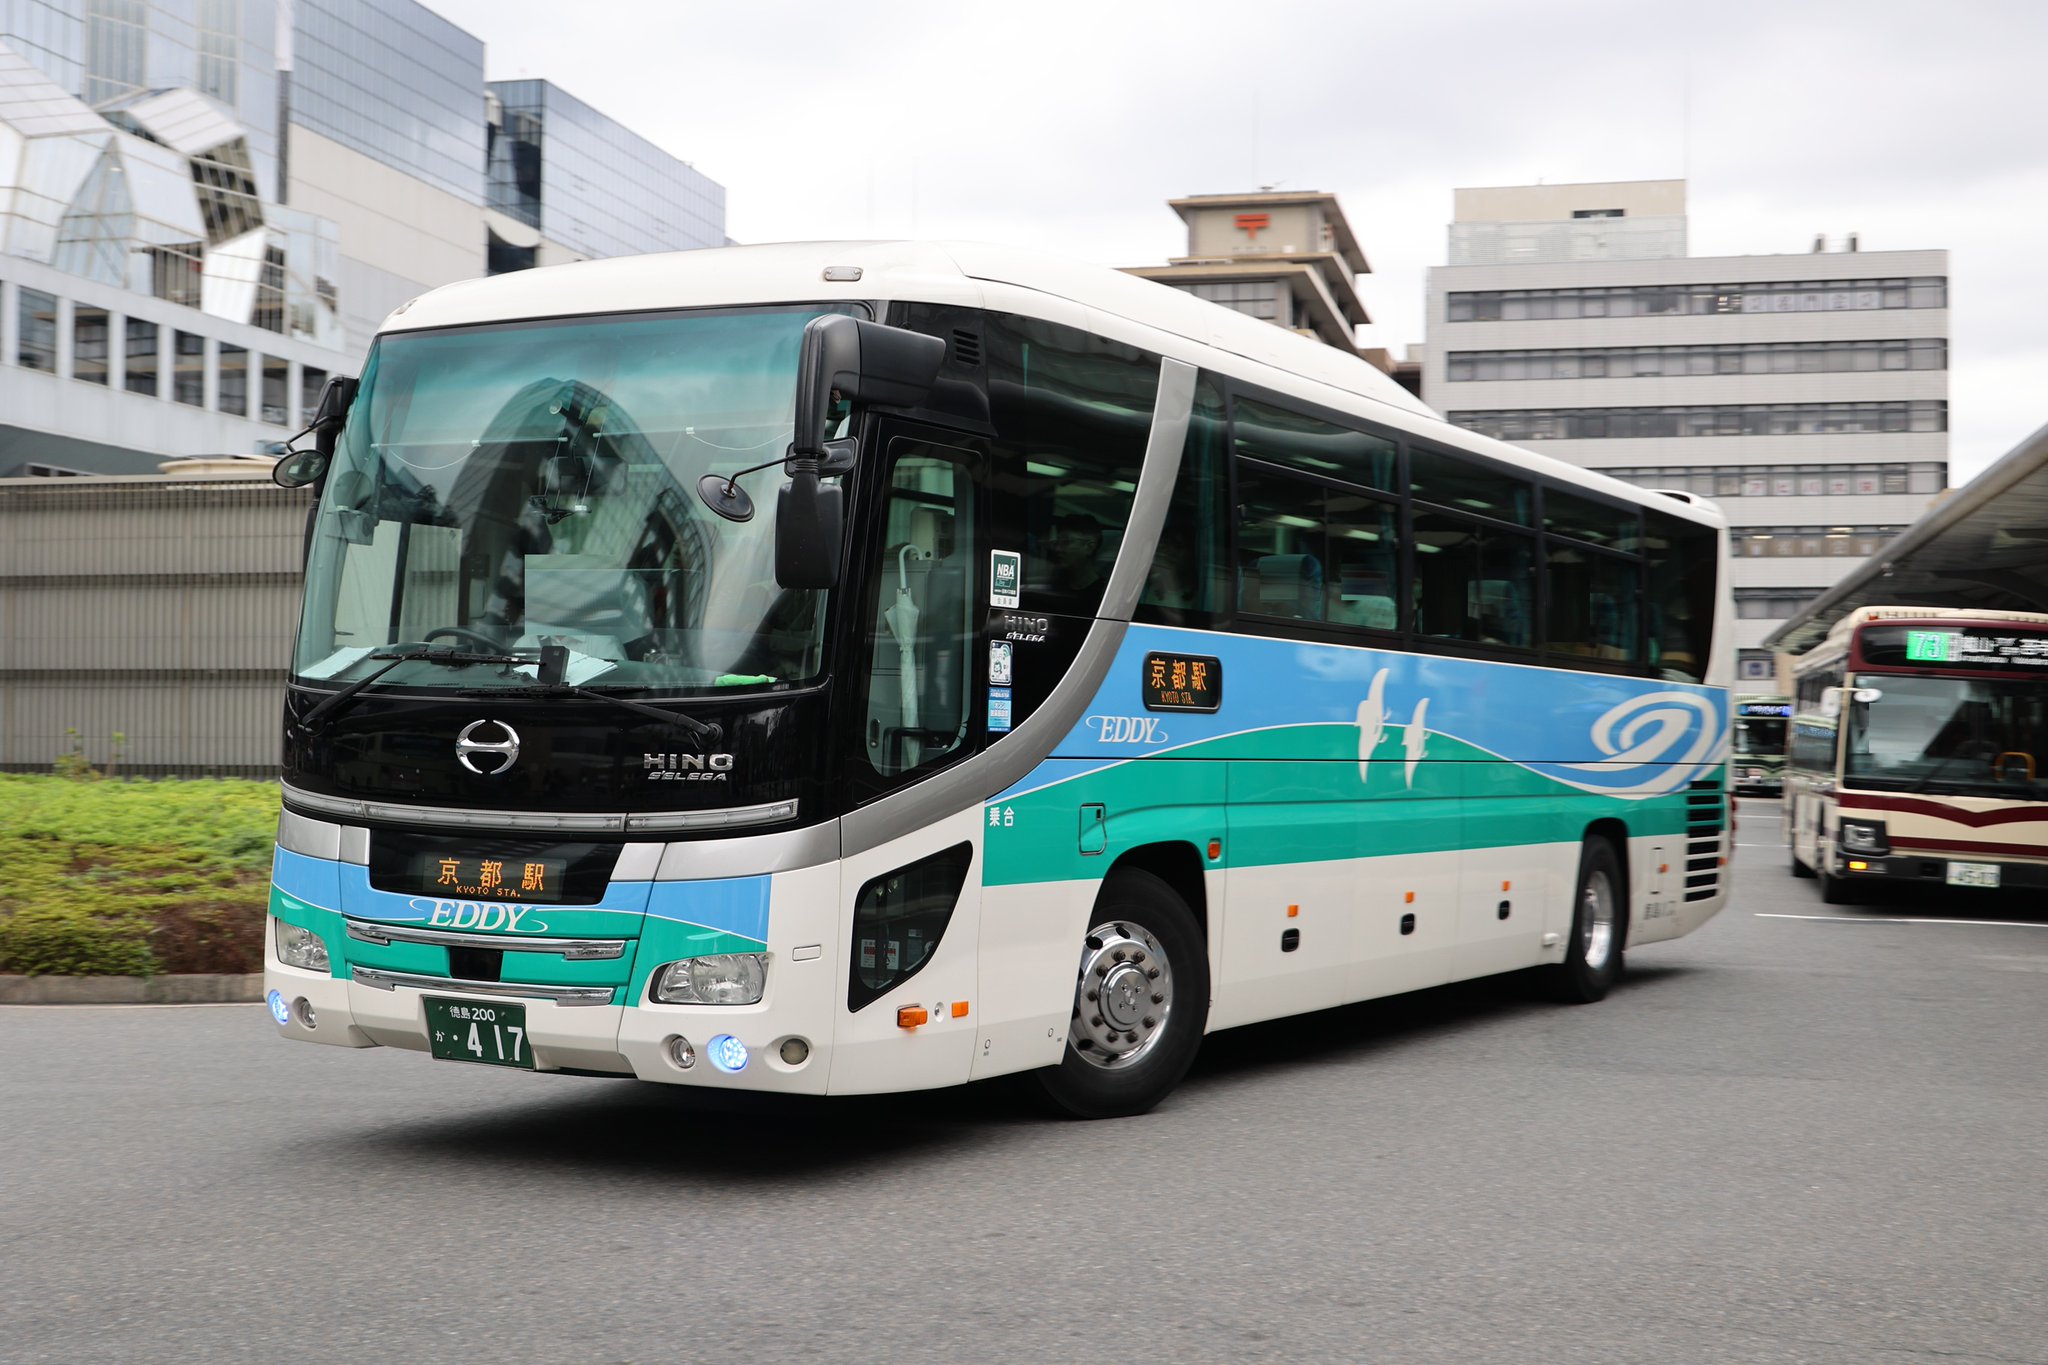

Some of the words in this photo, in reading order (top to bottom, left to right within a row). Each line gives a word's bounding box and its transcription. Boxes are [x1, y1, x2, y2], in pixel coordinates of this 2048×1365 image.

[997, 563, 1015, 577] NBA
[1004, 615, 1048, 633] HINO
[1914, 634, 1942, 658] 73
[1150, 658, 1207, 691] 京都駅
[1161, 690, 1179, 703] KYOTO
[1098, 715, 1160, 743] EDDY
[643, 753, 733, 771] HINO
[989, 806, 1015, 827] 乗合
[437, 857, 545, 891] 京都駅
[456, 885, 490, 895] KYOTO
[497, 887, 521, 898] STA.
[427, 900, 533, 933] EDDY
[435, 1030, 445, 1042] か
